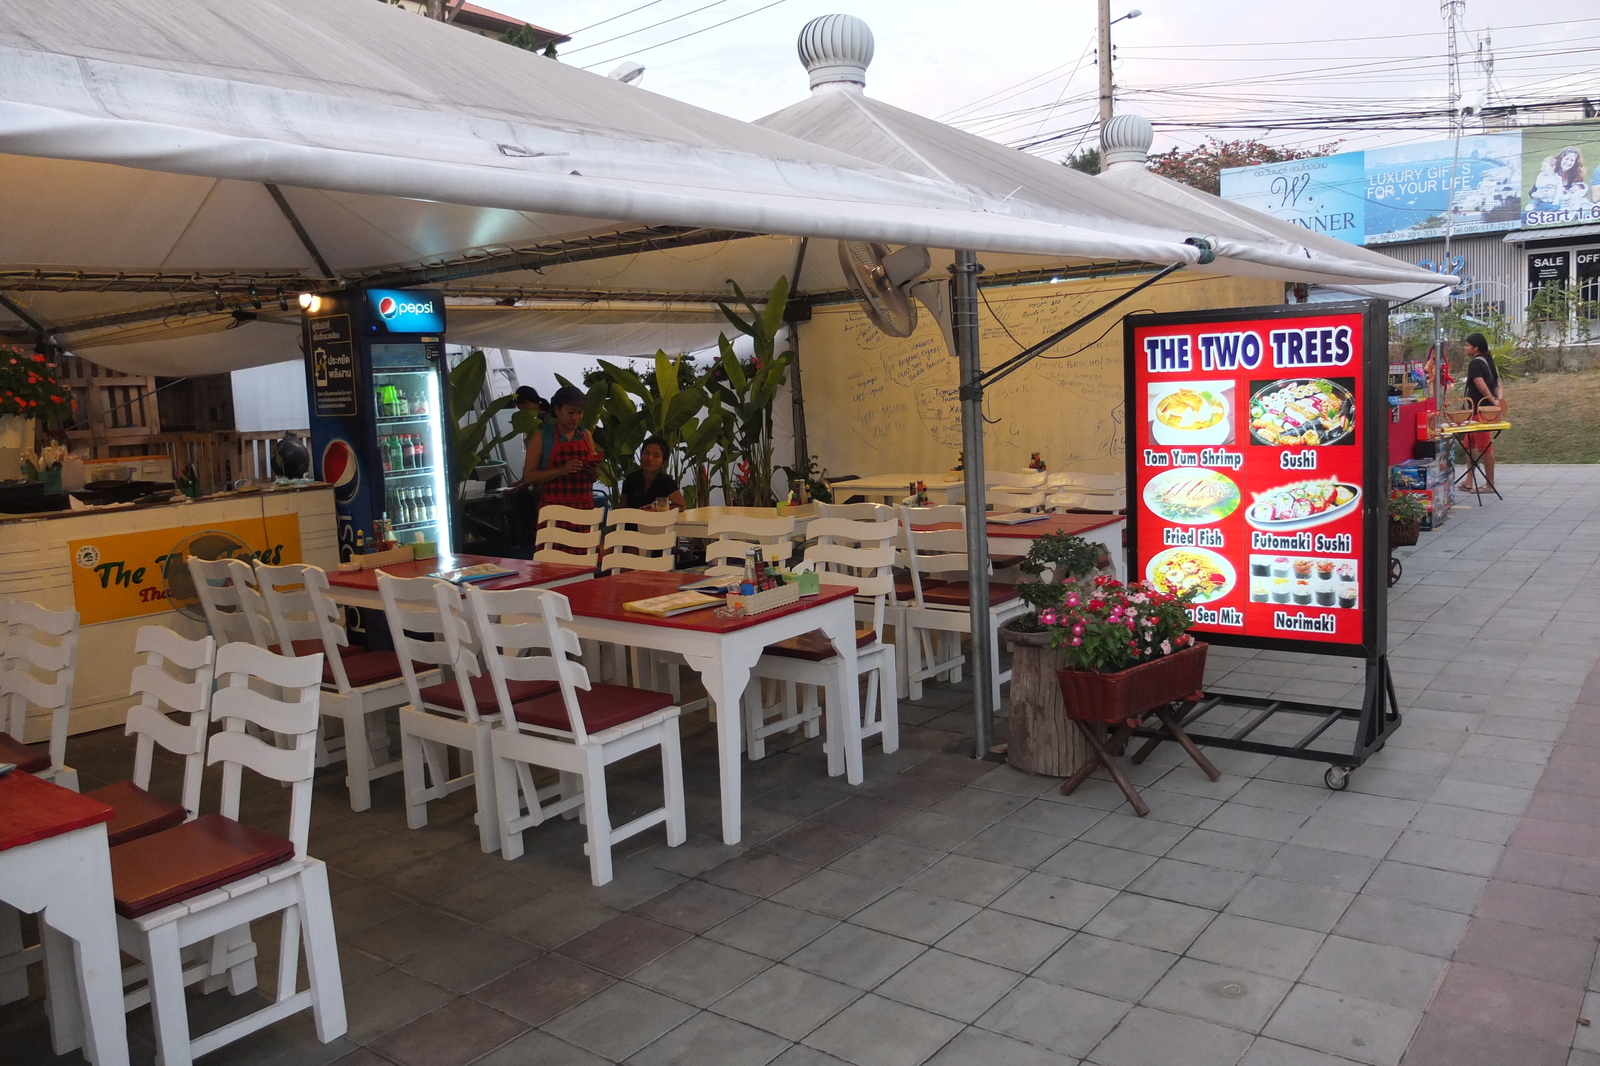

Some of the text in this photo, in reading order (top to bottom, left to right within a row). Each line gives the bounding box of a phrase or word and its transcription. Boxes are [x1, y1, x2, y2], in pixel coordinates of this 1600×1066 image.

[1367, 185, 1395, 199] FOR
[1399, 179, 1437, 195] YOUR
[1527, 209, 1570, 225] Start
[1534, 256, 1564, 268] SALE
[399, 301, 433, 315] pepsi
[1145, 329, 1350, 370] THE TWO TREES
[1144, 451, 1242, 469] Tom Yum Shrimp
[1280, 452, 1316, 469] Sushi
[1164, 530, 1223, 547] Fried Fish
[1252, 534, 1351, 553] Futomaki Sushi
[94, 560, 147, 589] The
[1197, 608, 1217, 624] Sea
[1220, 608, 1242, 626] Mix
[1274, 612, 1336, 632] Norimaki
